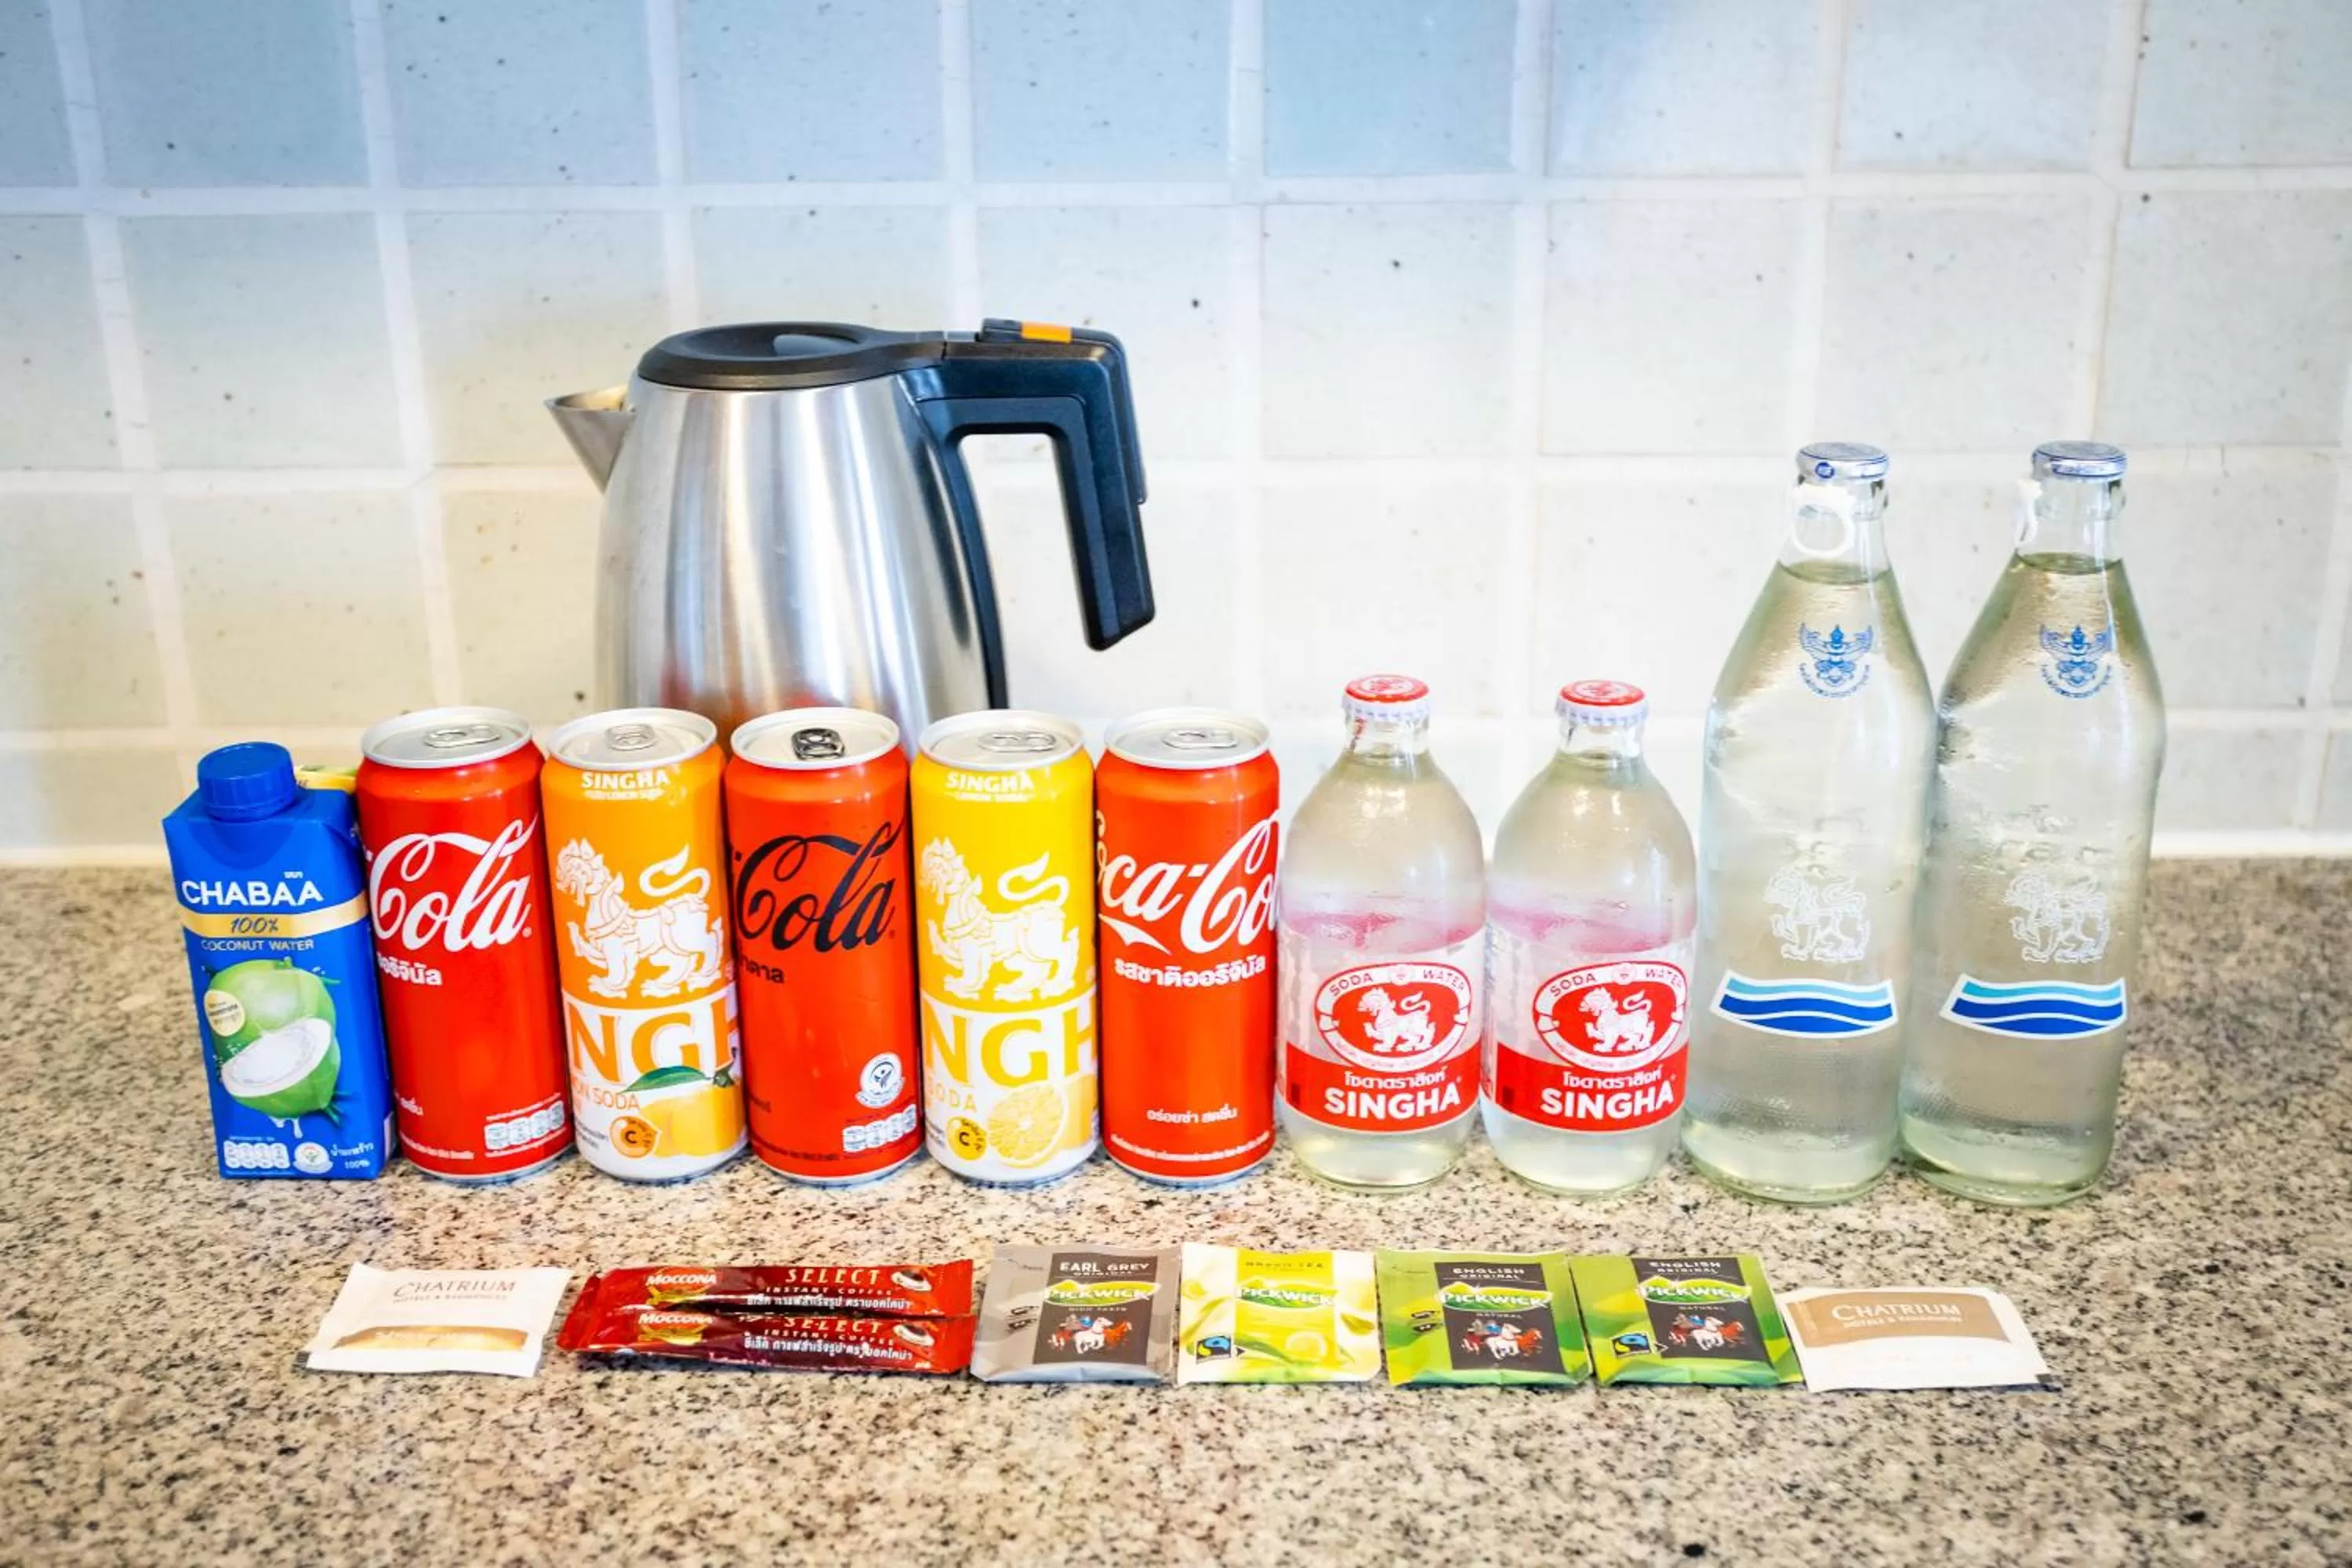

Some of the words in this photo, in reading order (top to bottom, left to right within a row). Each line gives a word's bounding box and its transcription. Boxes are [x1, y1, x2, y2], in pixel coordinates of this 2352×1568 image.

[582, 769, 671, 789] SINGHA
[945, 768, 1035, 792] SINGHA
[181, 880, 324, 906] CHABAA
[230, 917, 280, 934] 100%
[201, 940, 264, 952] COCONUT
[269, 938, 314, 951] WATER
[1330, 972, 1374, 996] SODA
[1423, 969, 1465, 991] WATER
[1550, 972, 1597, 996] SODA
[592, 1087, 641, 1110] SODA
[1324, 1082, 1461, 1120] SINGHA
[1541, 1080, 1674, 1120] SINGHA
[1060, 1261, 1102, 1272] EARL
[1107, 1263, 1150, 1272] GREY
[646, 1274, 717, 1286] MOCCONA
[786, 1269, 881, 1285] SELECT
[393, 1280, 515, 1298] CHATRIUM
[838, 1287, 893, 1296] COFFEE
[1044, 1287, 1151, 1301] PICKWICK
[1439, 1292, 1549, 1308] PICKWICK
[638, 1313, 713, 1325] MOCCONA
[1831, 1304, 1962, 1321] CHATRIUM
[764, 1329, 829, 1339] INSTANT
[785, 1317, 884, 1334] SELECT
